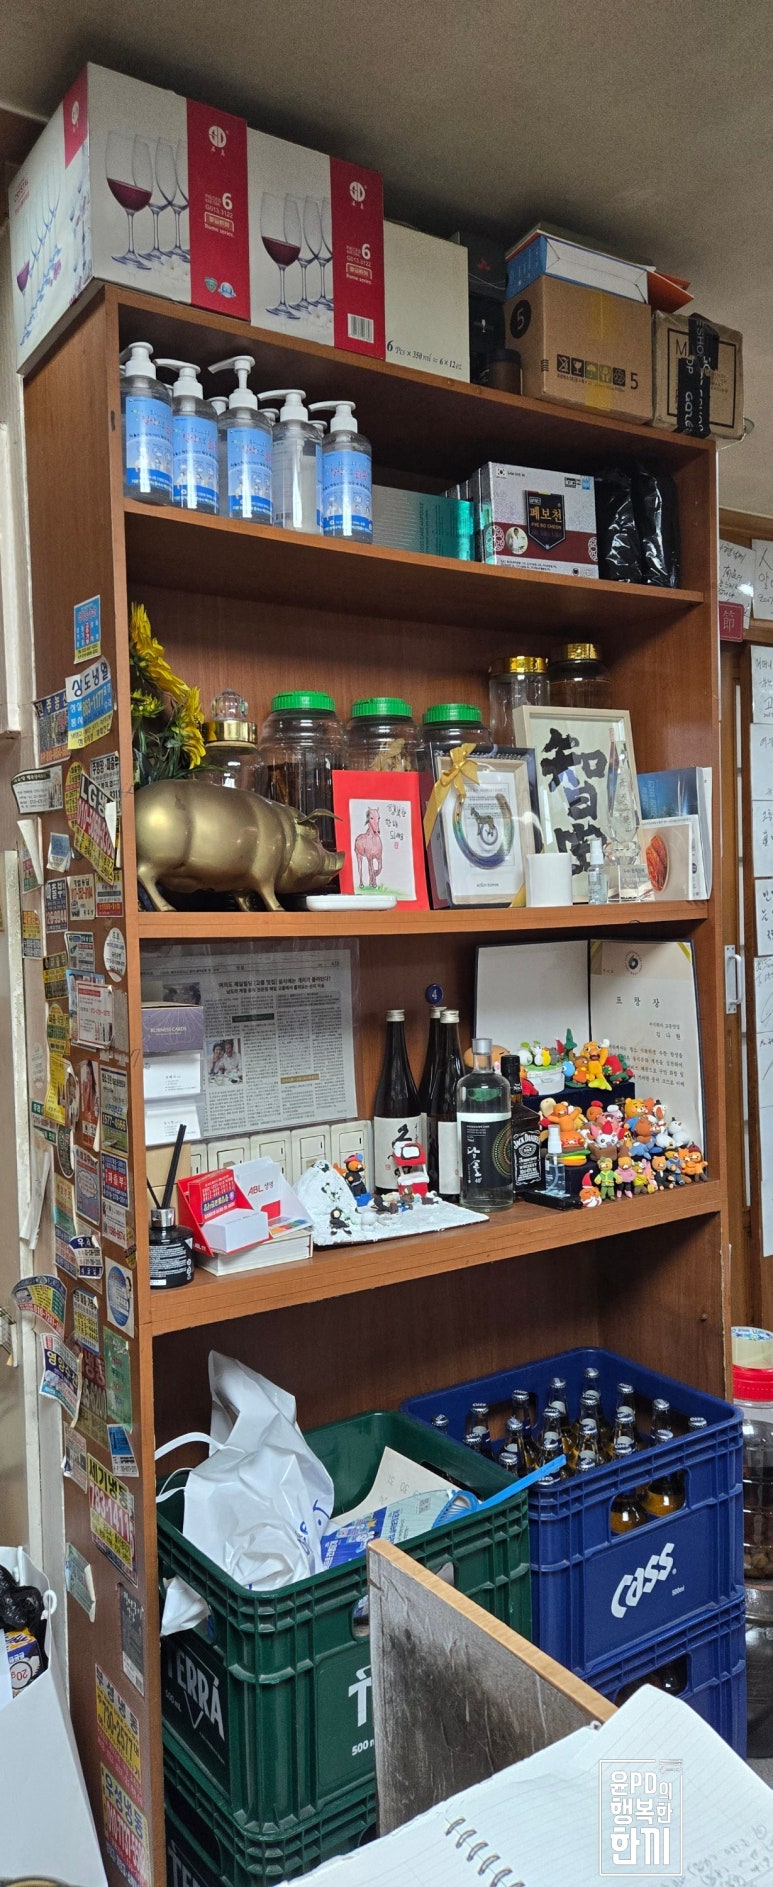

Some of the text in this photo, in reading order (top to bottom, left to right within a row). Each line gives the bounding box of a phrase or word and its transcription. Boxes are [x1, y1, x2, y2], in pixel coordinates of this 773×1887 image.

[222, 192, 233, 210] 6
[361, 243, 371, 260] 6
[516, 311, 525, 329] 5
[630, 372, 639, 390] 5
[431, 988, 438, 1000] 4
[247, 1184, 264, 1196] ABL
[610, 1542, 675, 1619] Cass
[167, 1650, 225, 1741] TERRA
[351, 1739, 369, 1756] 500
